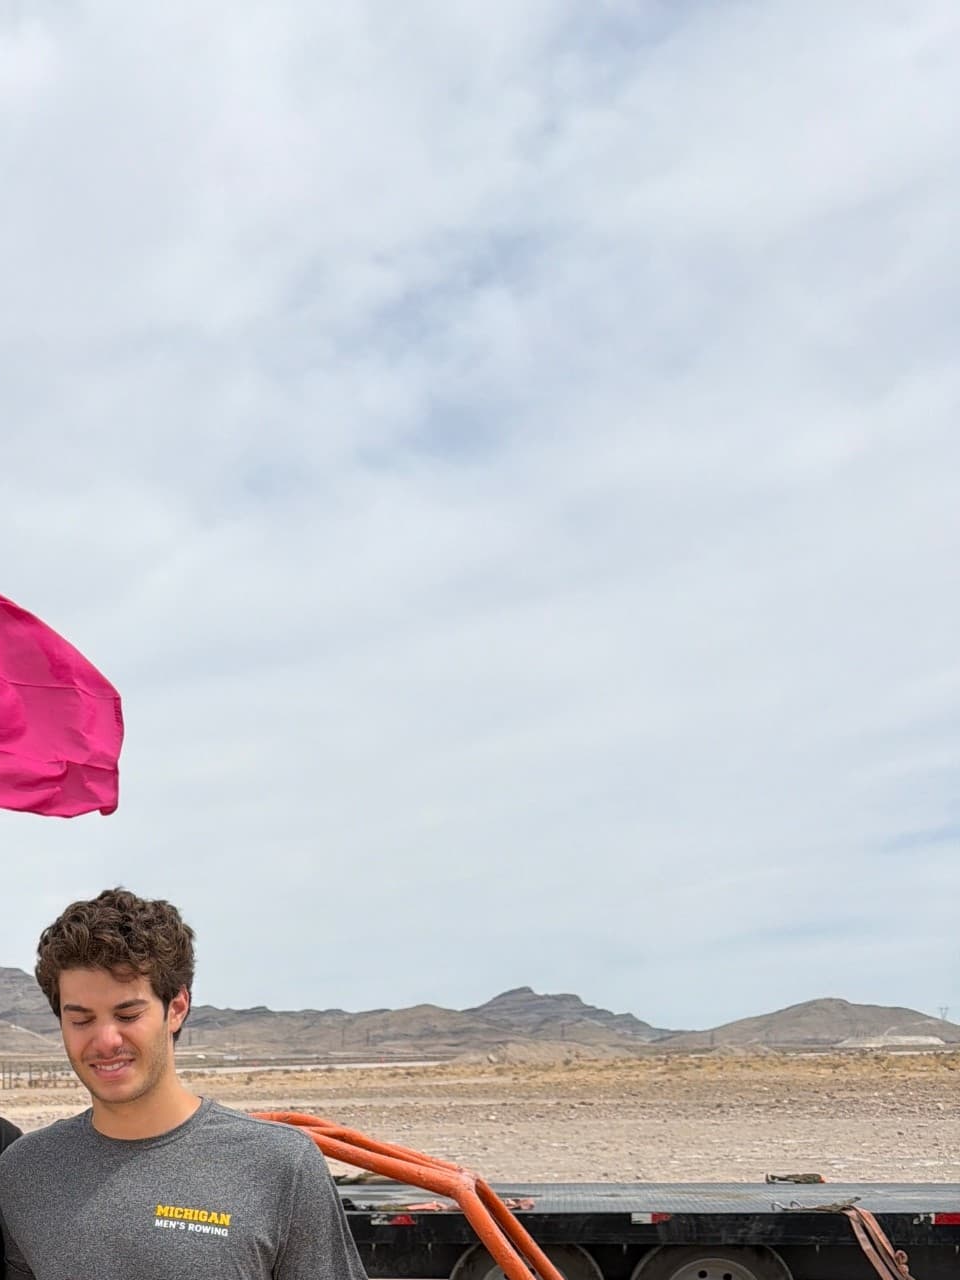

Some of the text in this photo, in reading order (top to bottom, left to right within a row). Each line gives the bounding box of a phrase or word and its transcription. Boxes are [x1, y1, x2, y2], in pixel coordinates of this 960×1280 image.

[156, 1205, 232, 1226] MICHIGAN
[155, 1219, 229, 1237] MEN'S ROWING
